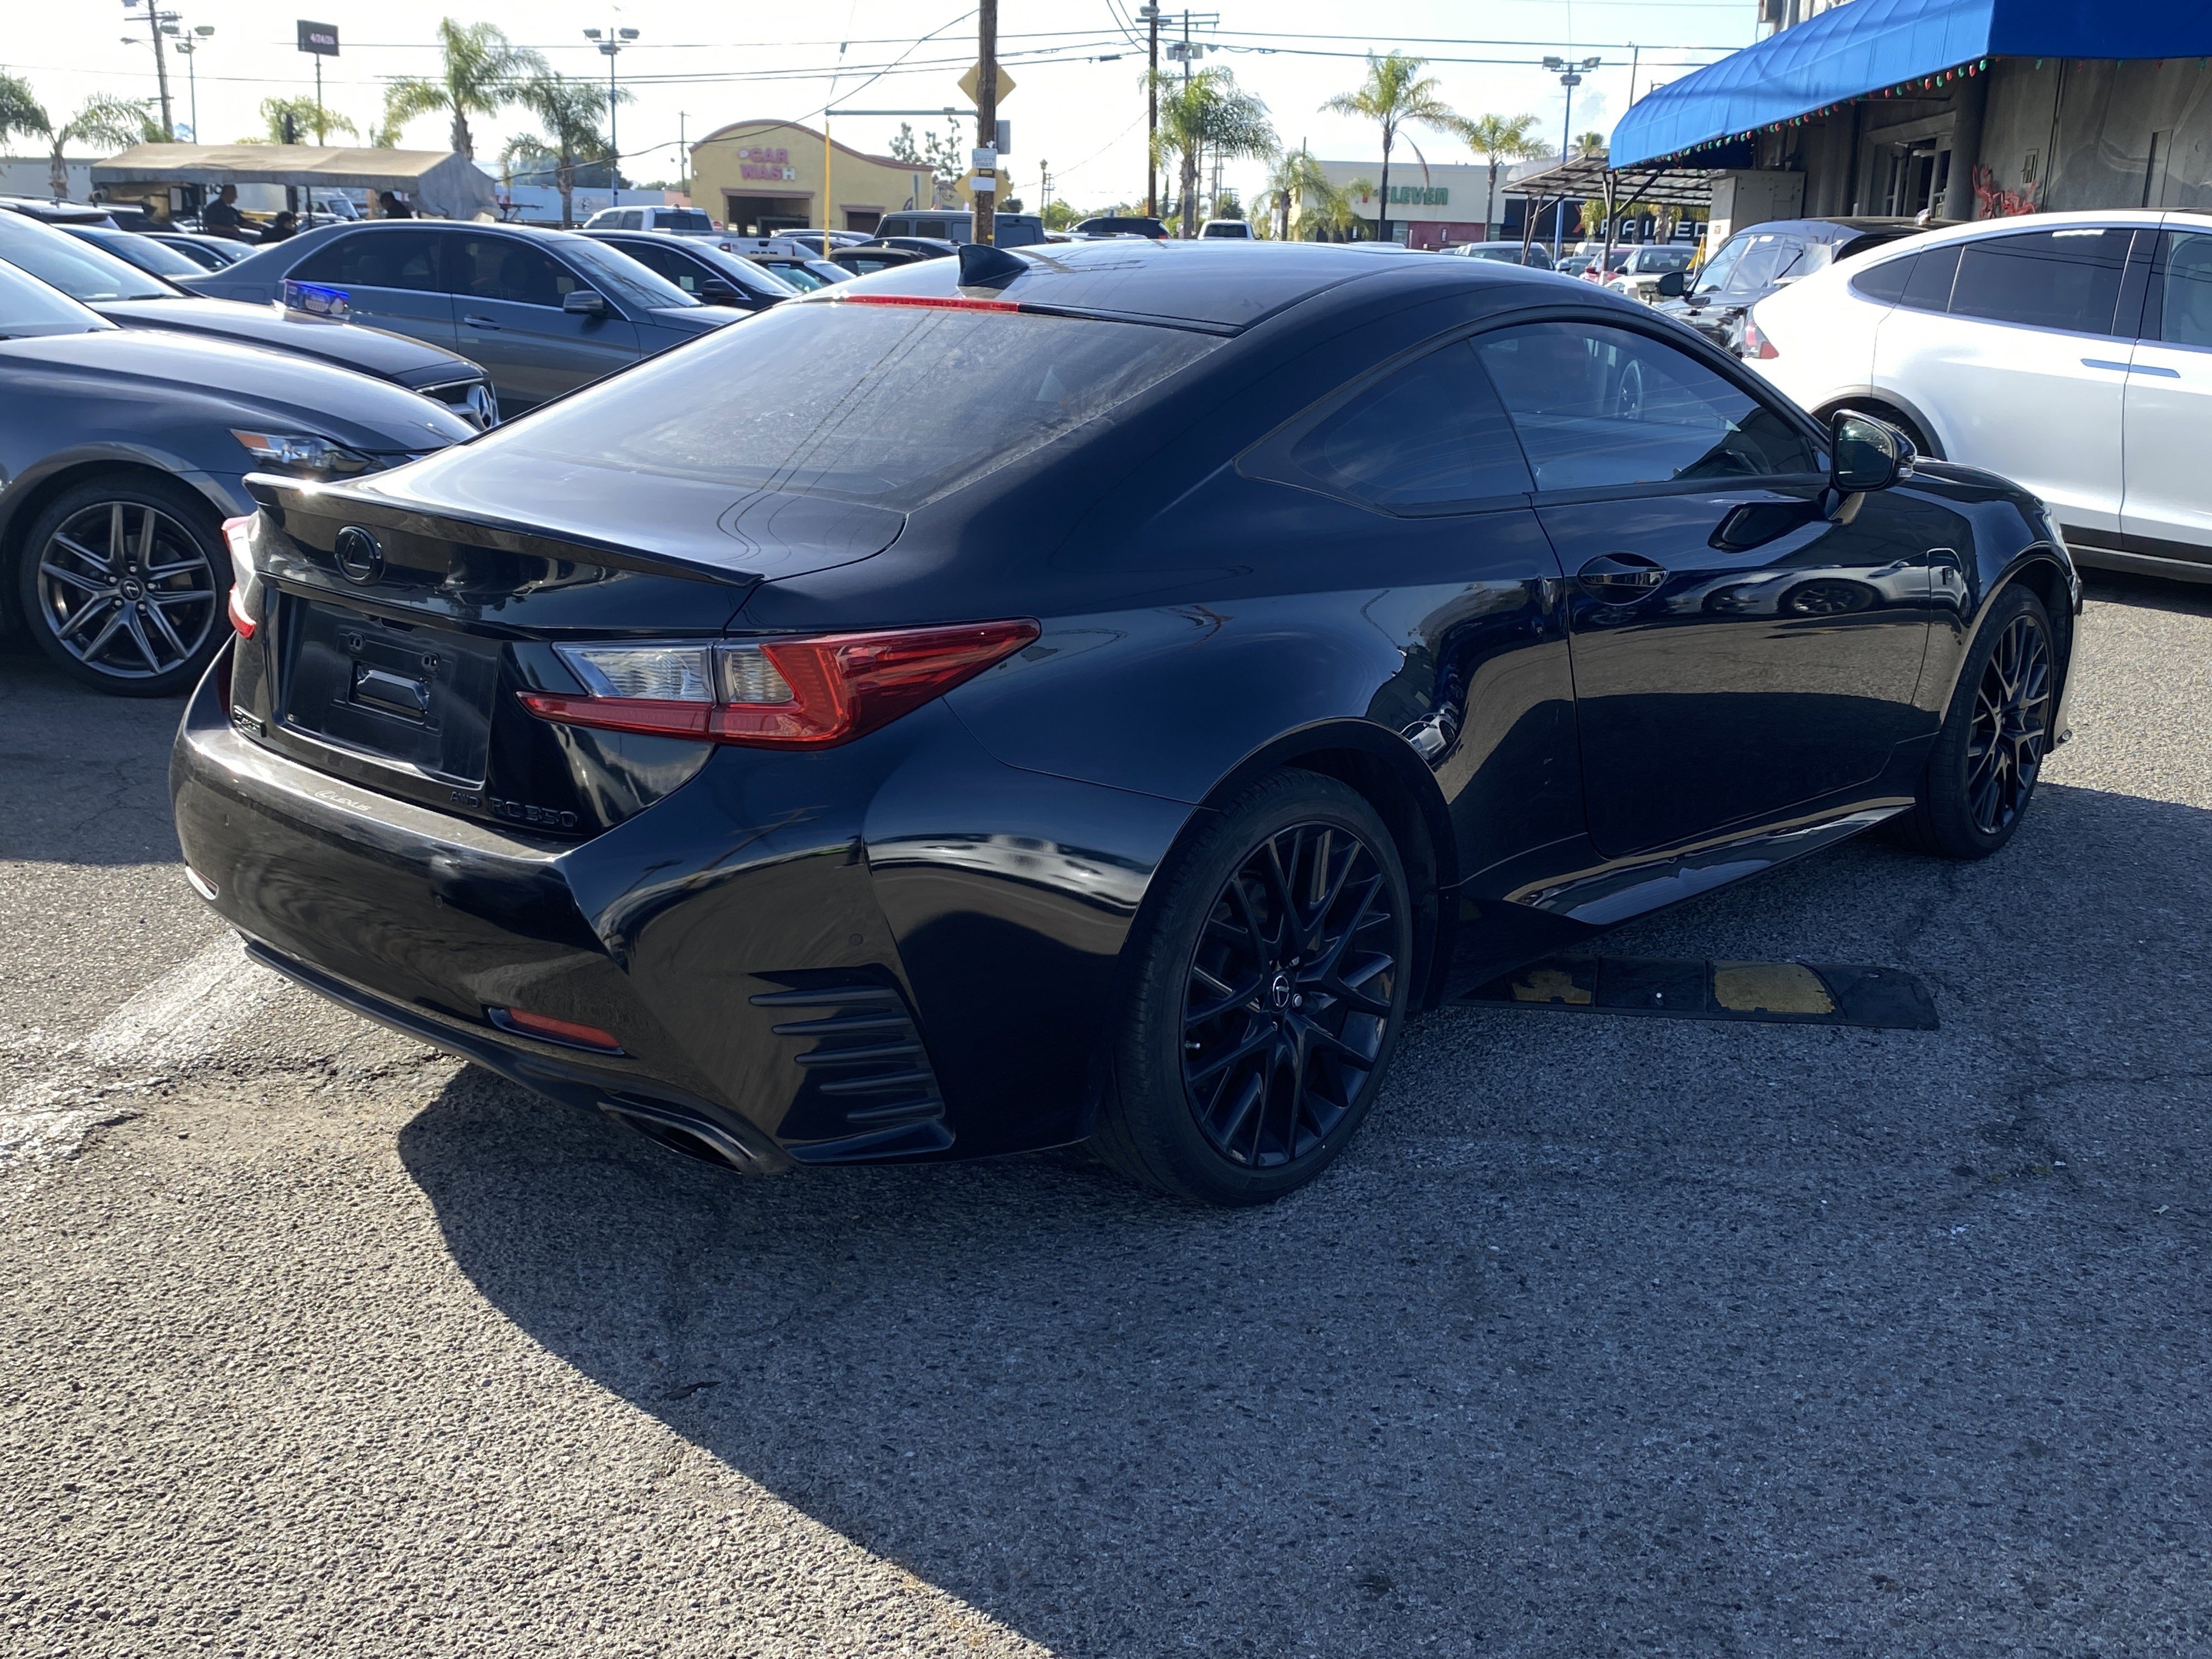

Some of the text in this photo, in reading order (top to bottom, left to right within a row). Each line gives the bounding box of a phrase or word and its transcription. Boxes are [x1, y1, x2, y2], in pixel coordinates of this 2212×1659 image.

[749, 147, 789, 163] CAR
[740, 164, 795, 180] WASH
[330, 795, 372, 811] LEXUS
[450, 791, 481, 809] AWD
